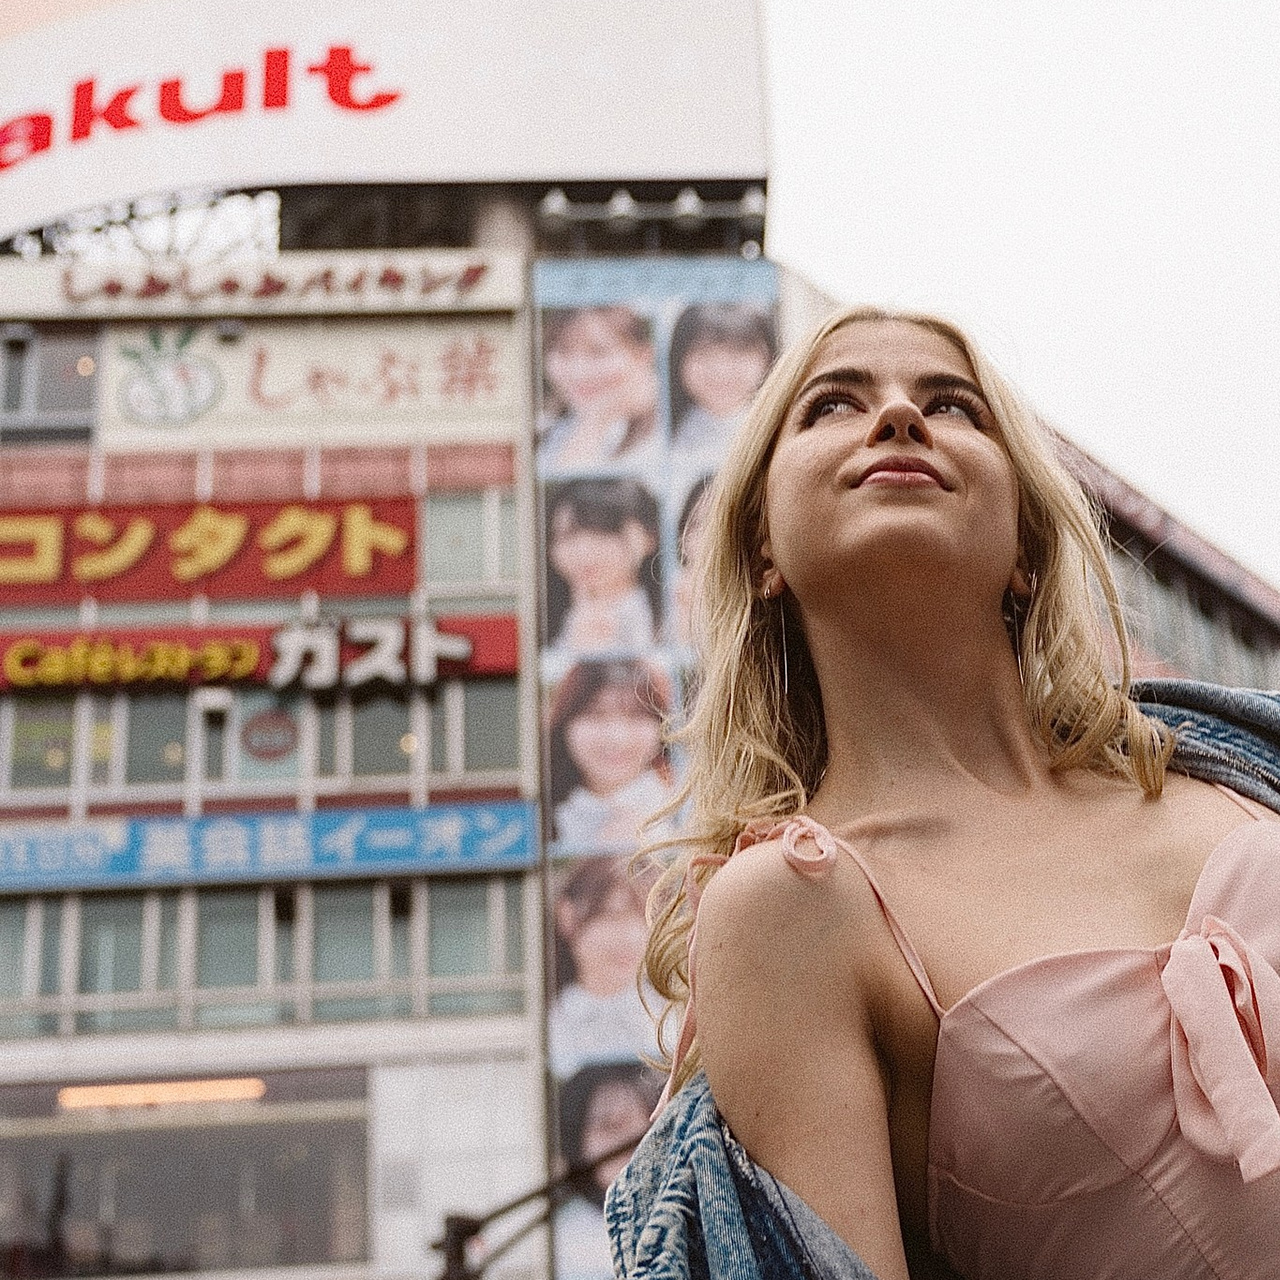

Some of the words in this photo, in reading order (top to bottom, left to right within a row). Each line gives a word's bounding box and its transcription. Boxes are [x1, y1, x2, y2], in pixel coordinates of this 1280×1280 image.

[0, 503, 408, 584] コンタクト
[270, 620, 474, 689] ガスト
